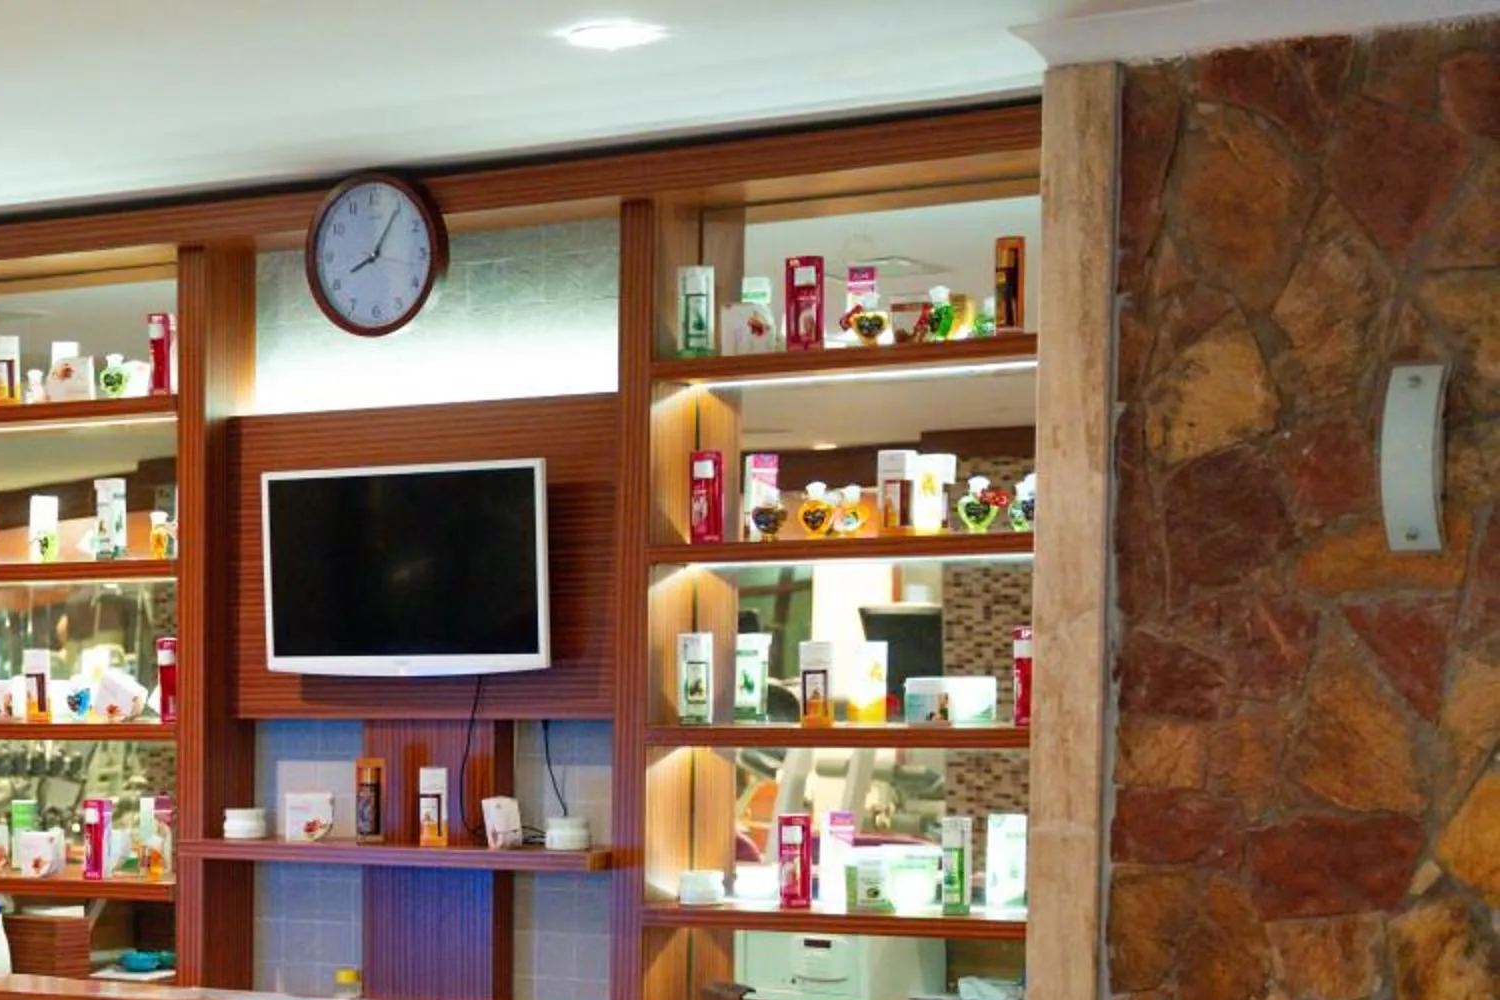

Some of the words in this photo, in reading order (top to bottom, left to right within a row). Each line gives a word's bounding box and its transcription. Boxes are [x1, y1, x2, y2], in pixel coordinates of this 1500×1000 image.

[349, 202, 358, 216] 11
[333, 223, 346, 237] 10
[411, 219, 421, 233] 2
